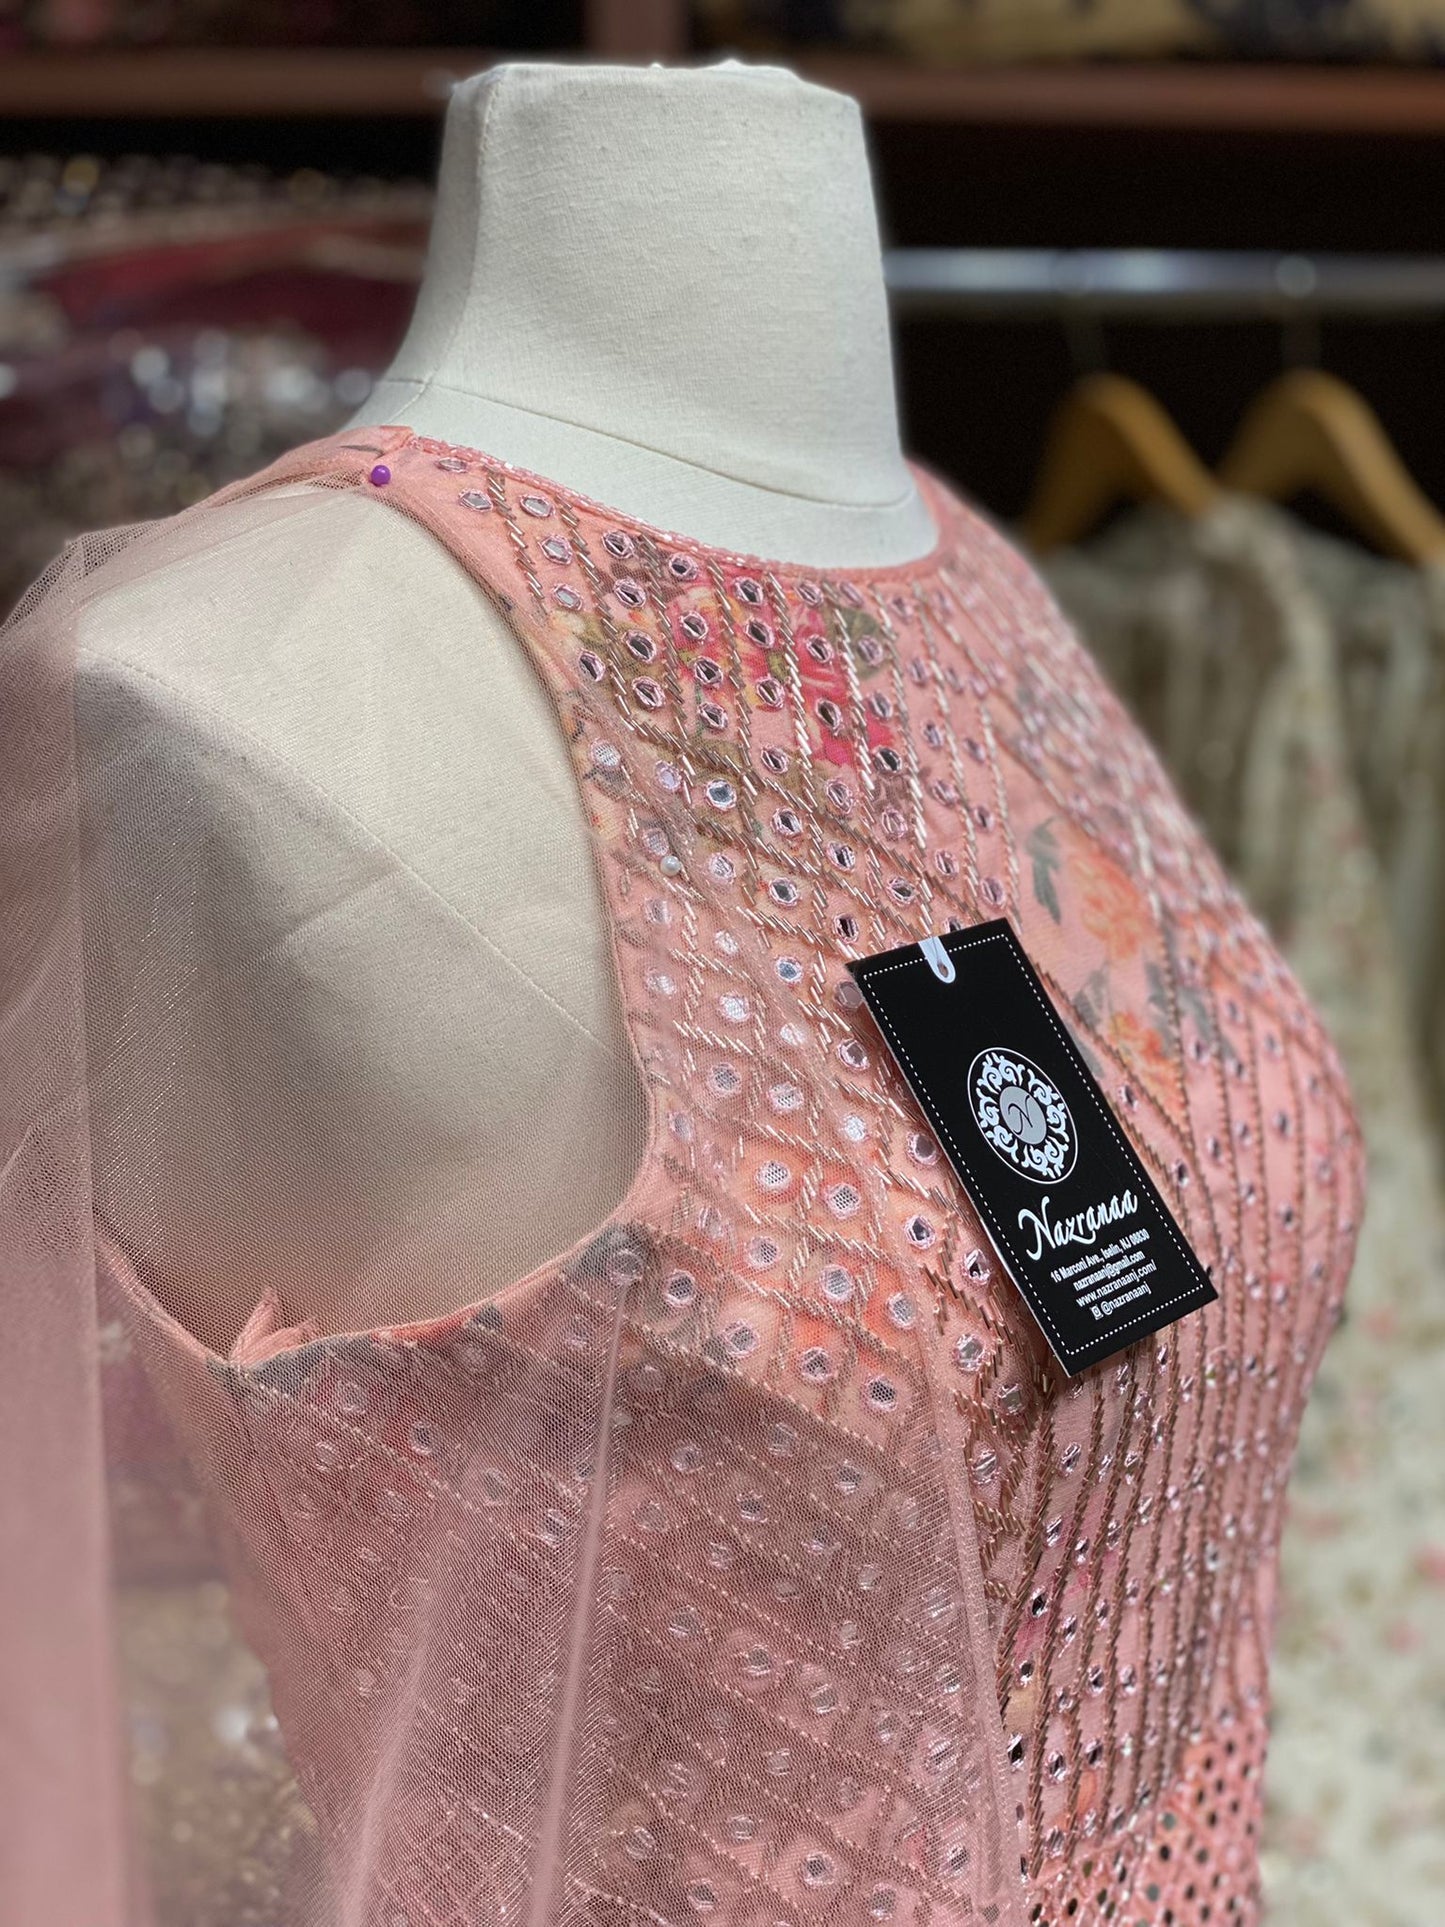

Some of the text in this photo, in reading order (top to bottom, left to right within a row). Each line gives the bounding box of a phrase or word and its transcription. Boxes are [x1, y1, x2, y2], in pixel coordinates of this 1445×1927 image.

[1017, 1189, 1138, 1261] Nazranaa
[1050, 1270, 1062, 1283] 16
[1058, 1257, 1088, 1279] Marconi
[1100, 1243, 1124, 1259] Iselin,
[1119, 1236, 1132, 1250] NJ
[1073, 1250, 1146, 1291] nazranaanj@gmail.com
[1100, 1280, 1152, 1316] @nazranaanj
